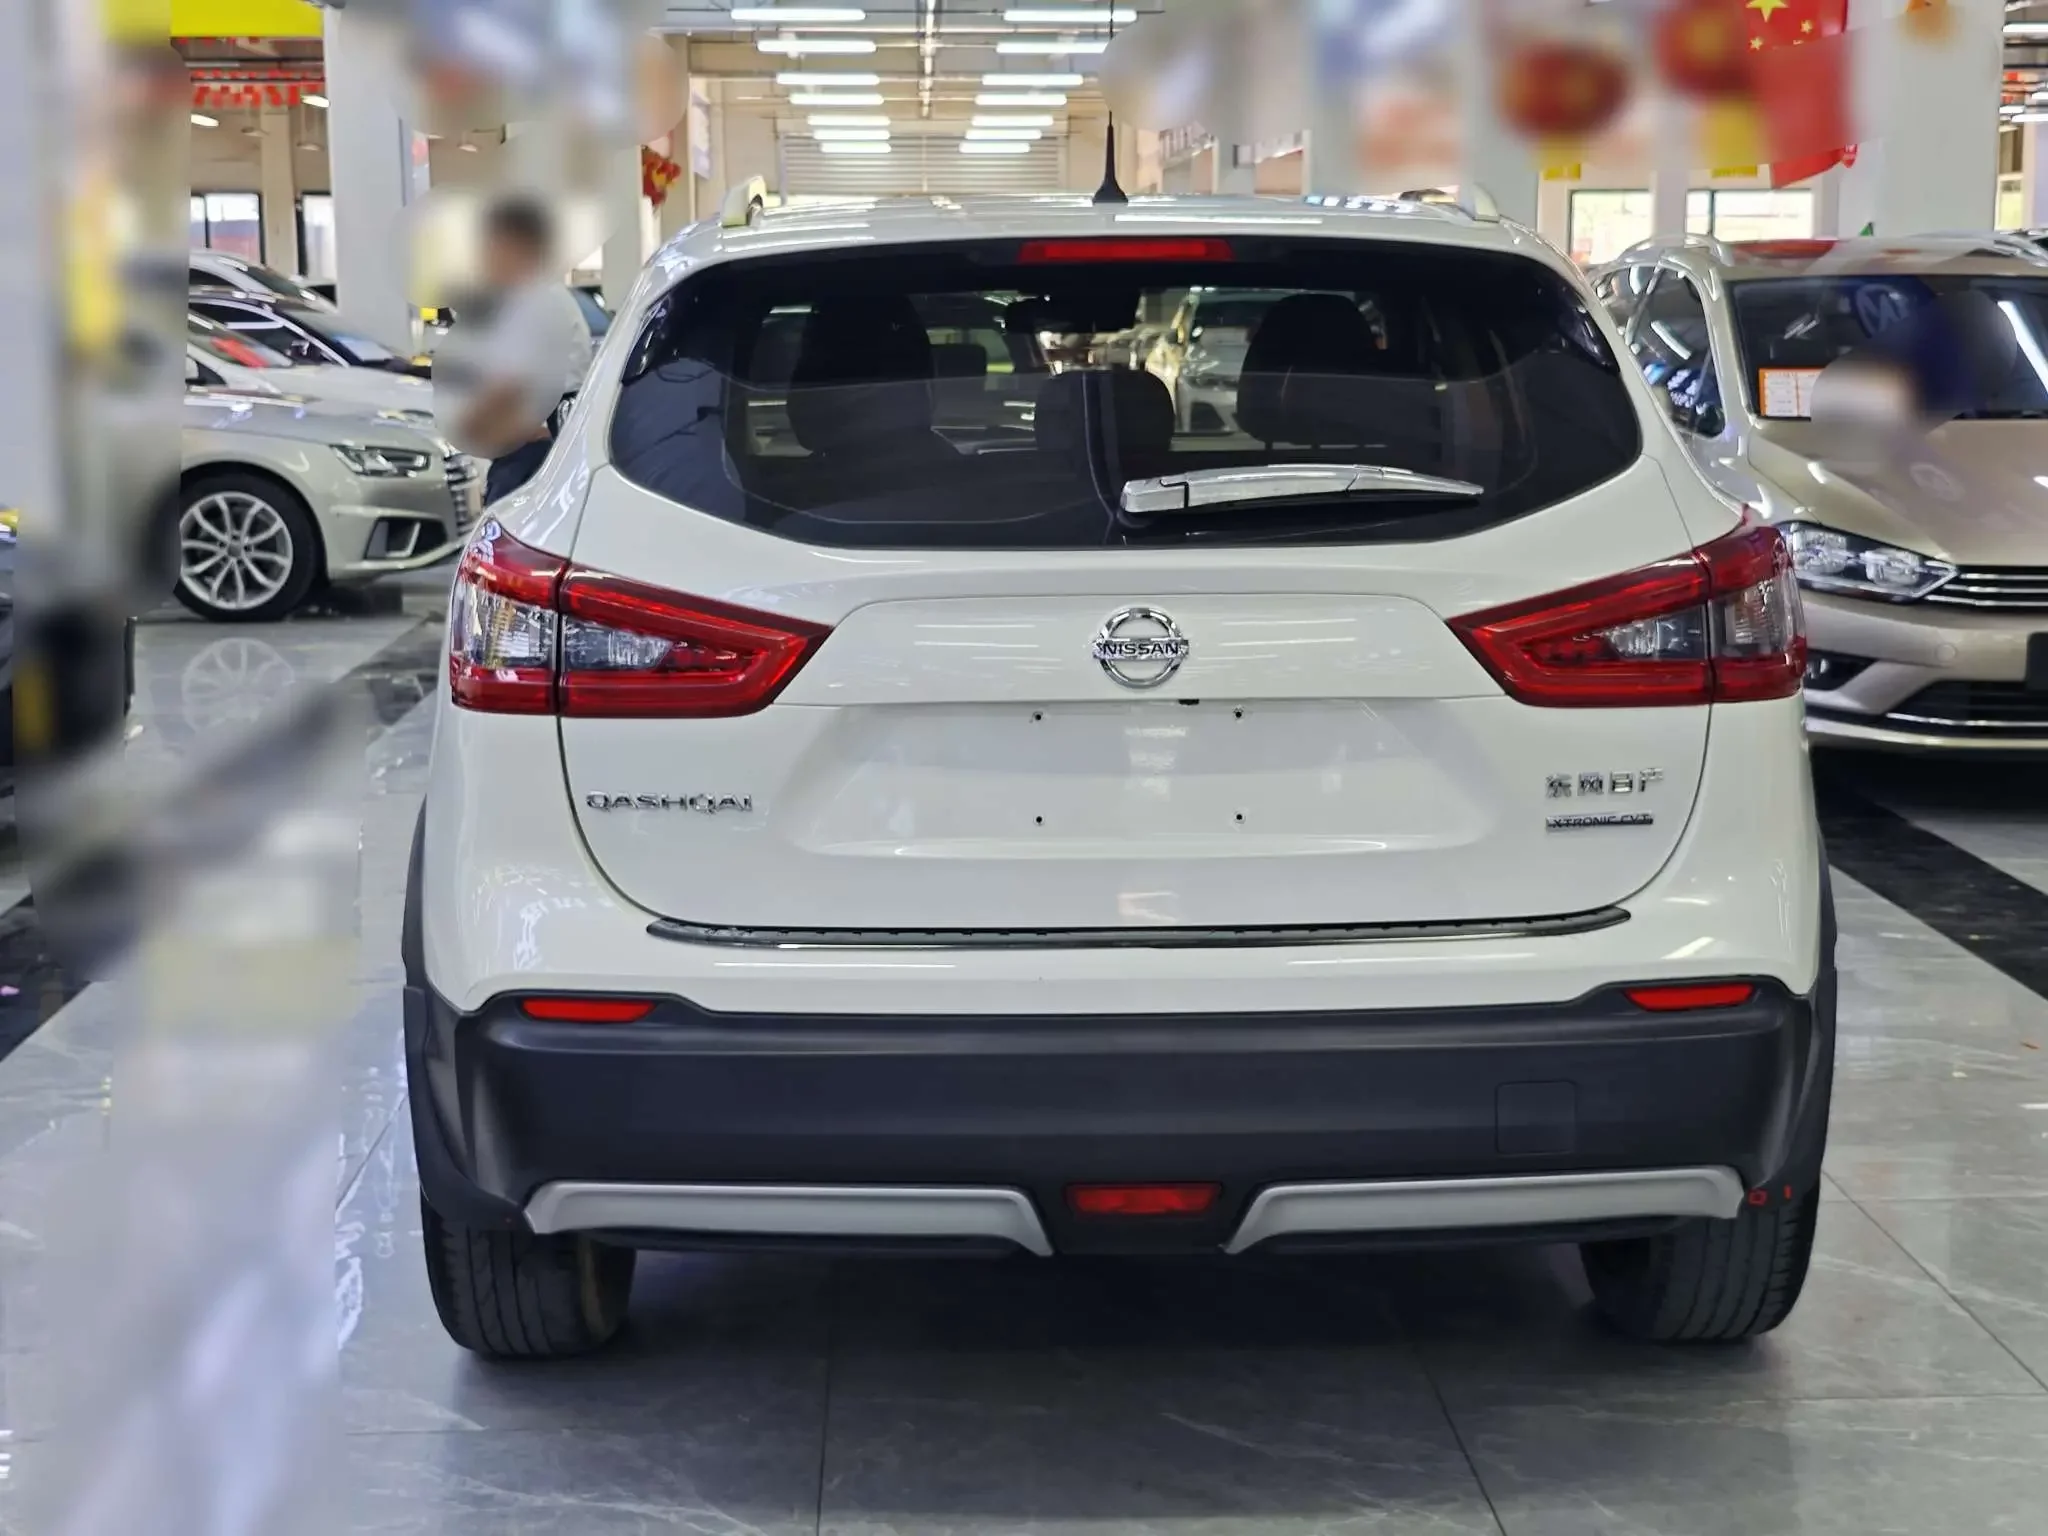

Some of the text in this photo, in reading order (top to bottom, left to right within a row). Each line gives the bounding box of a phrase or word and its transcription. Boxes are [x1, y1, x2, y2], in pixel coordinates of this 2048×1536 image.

[1102, 642, 1179, 655] NISSAN
[1545, 767, 1663, 799] 东风日产
[586, 790, 753, 814] QASHQAI
